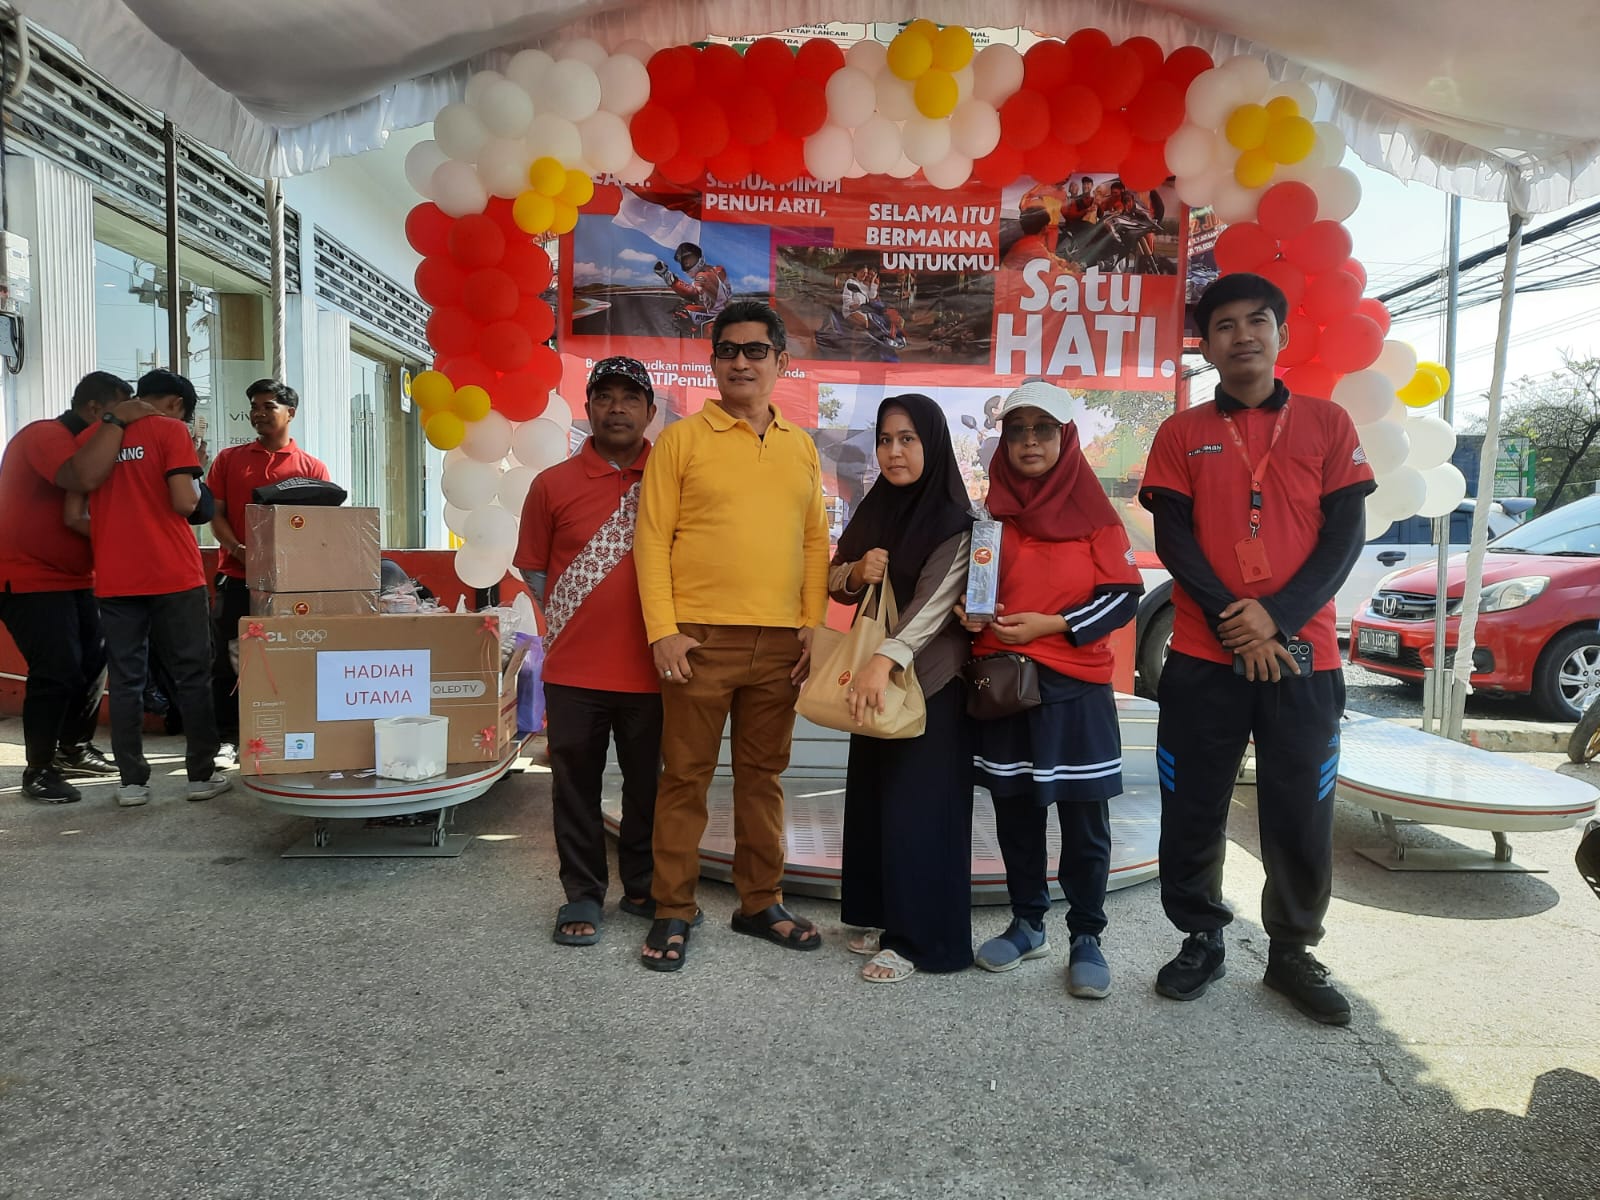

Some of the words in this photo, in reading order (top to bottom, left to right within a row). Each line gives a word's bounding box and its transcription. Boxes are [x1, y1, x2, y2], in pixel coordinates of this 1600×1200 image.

[705, 192, 773, 212] PENUH
[777, 197, 827, 217] ARTI,
[869, 203, 958, 224] SELAMA
[962, 206, 995, 225] ITU
[866, 226, 993, 248] BERMAKNA
[882, 252, 1000, 271] UNTUKMU.
[1019, 257, 1143, 313] Satu
[994, 313, 1176, 378] HATI.
[344, 663, 414, 679] HADIAH
[345, 689, 413, 706] UTAMA
[432, 684, 461, 694] QLED
[462, 683, 478, 693] TV
